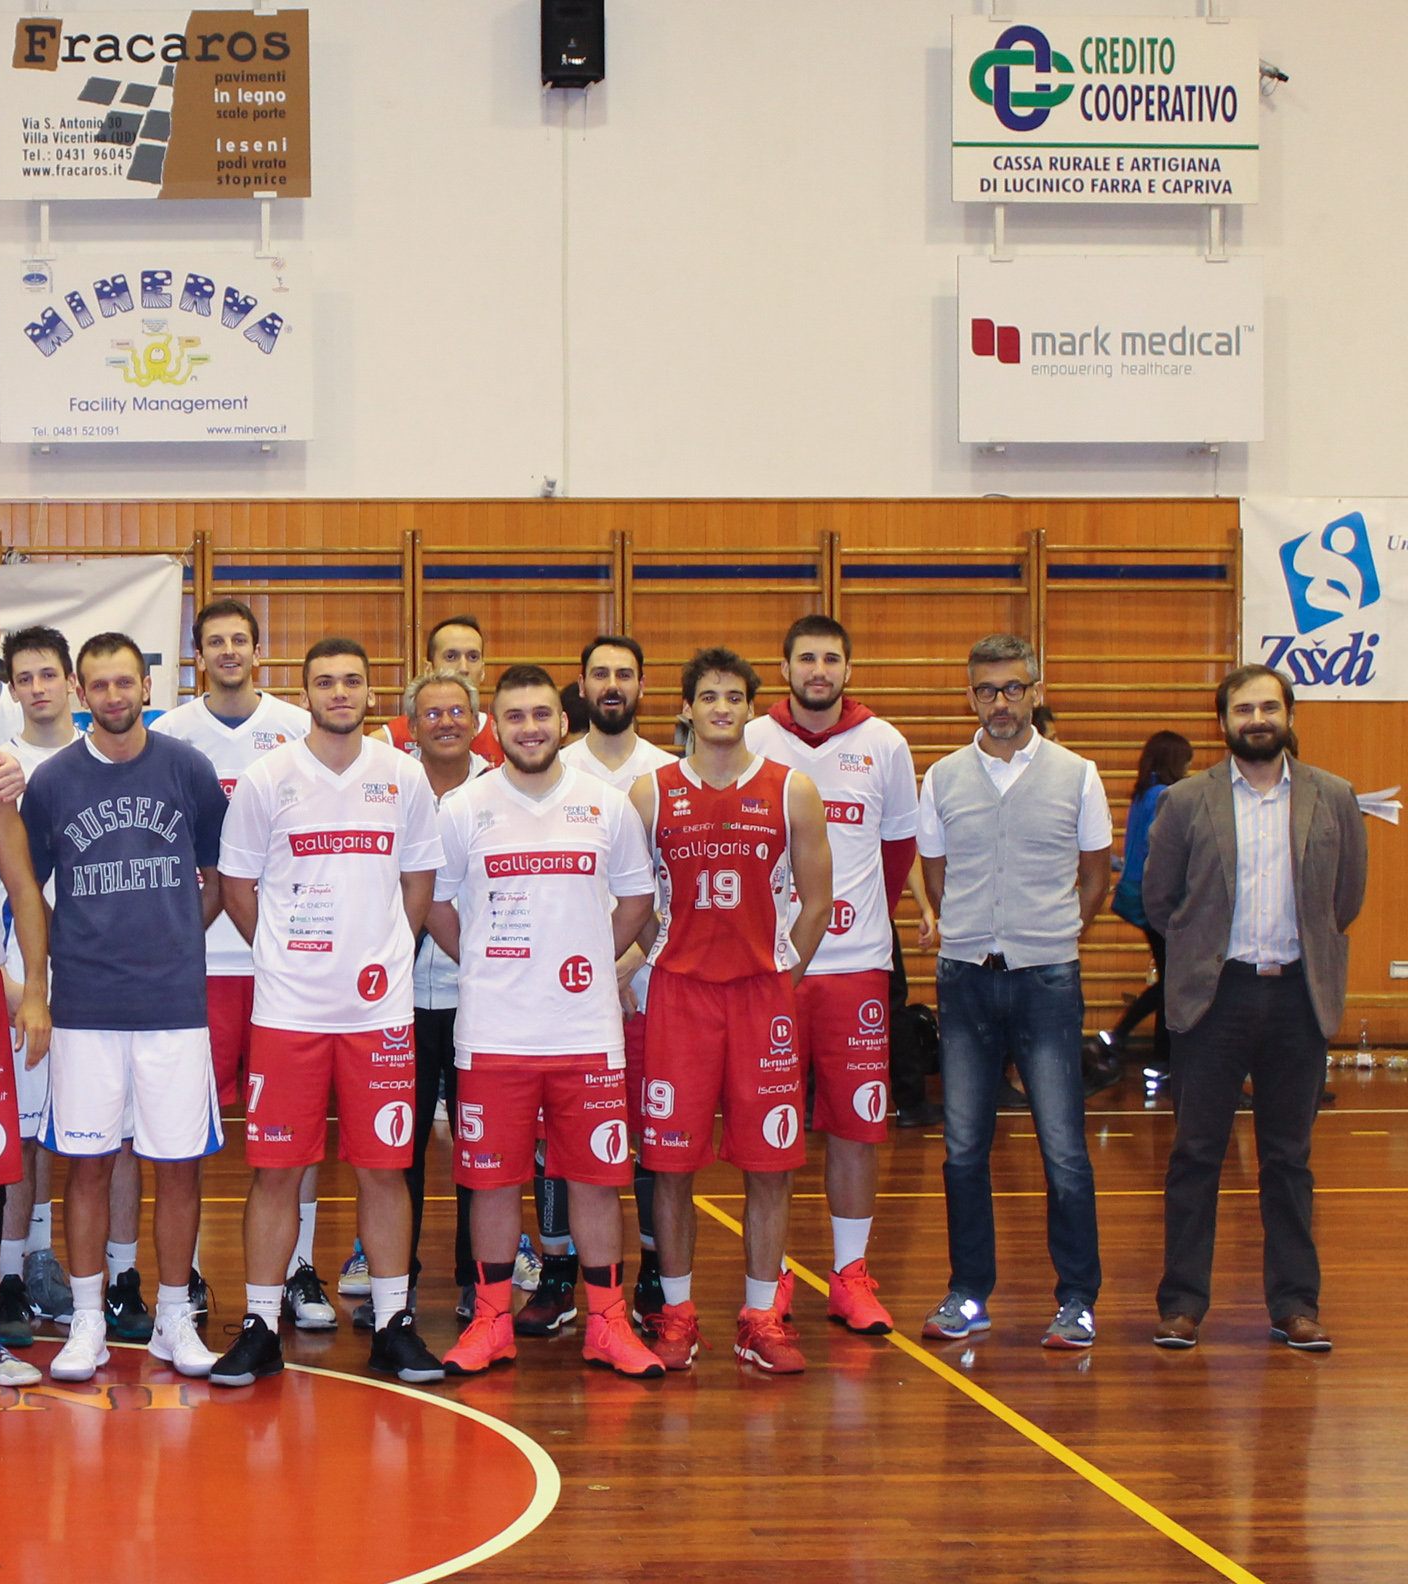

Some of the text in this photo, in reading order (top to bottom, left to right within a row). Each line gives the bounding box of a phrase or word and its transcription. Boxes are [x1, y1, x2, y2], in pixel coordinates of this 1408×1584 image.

[24, 25, 290, 63] Fracaros
[1080, 37, 1175, 75] CREDITO
[215, 70, 286, 86] pavimenti
[214, 87, 286, 107] in legno
[1080, 84, 1238, 122] COOPERATIVO
[216, 106, 286, 121] scale porte
[22, 117, 122, 130] Via S. Antonio 30
[22, 131, 136, 145] Villa Vicentina (UD)
[22, 148, 133, 161] Tel.: 0431 96045
[22, 164, 123, 177] www.fracaros.it
[217, 157, 286, 172] podi vrata
[993, 155, 1221, 172] CASSA RURALE E ARTIGIANA
[216, 173, 287, 188] stopnice
[980, 178, 1233, 194] DI LUCINICO FARRA E CAPRIVA
[23, 269, 284, 357] MINERVA
[1031, 325, 1111, 356] mark
[1121, 325, 1241, 356] medical
[1031, 362, 1112, 378] empowering
[69, 396, 248, 415] Facility Management
[32, 426, 120, 437] Tel. 0481 521091
[206, 424, 287, 436] www.minerva.it
[840, 761, 870, 774] basket
[365, 791, 396, 804] basket
[741, 804, 769, 816] basket
[64, 797, 183, 852] RUSSELL
[566, 813, 599, 825] basket
[683, 822, 715, 834] ENERGY
[295, 833, 372, 853] calligaris
[670, 840, 750, 861] calligaris
[489, 854, 573, 874] calligaris
[72, 856, 181, 896] ATHLETIC
[695, 869, 741, 910] 19
[828, 906, 854, 929] 18
[565, 961, 591, 987] 15
[367, 971, 380, 994] 7
[868, 1008, 878, 1019] B
[776, 1024, 788, 1037] B
[249, 1072, 265, 1113] 7
[264, 1132, 291, 1142] basket
[661, 1137, 689, 1148] basket
[474, 1159, 501, 1169] basket
